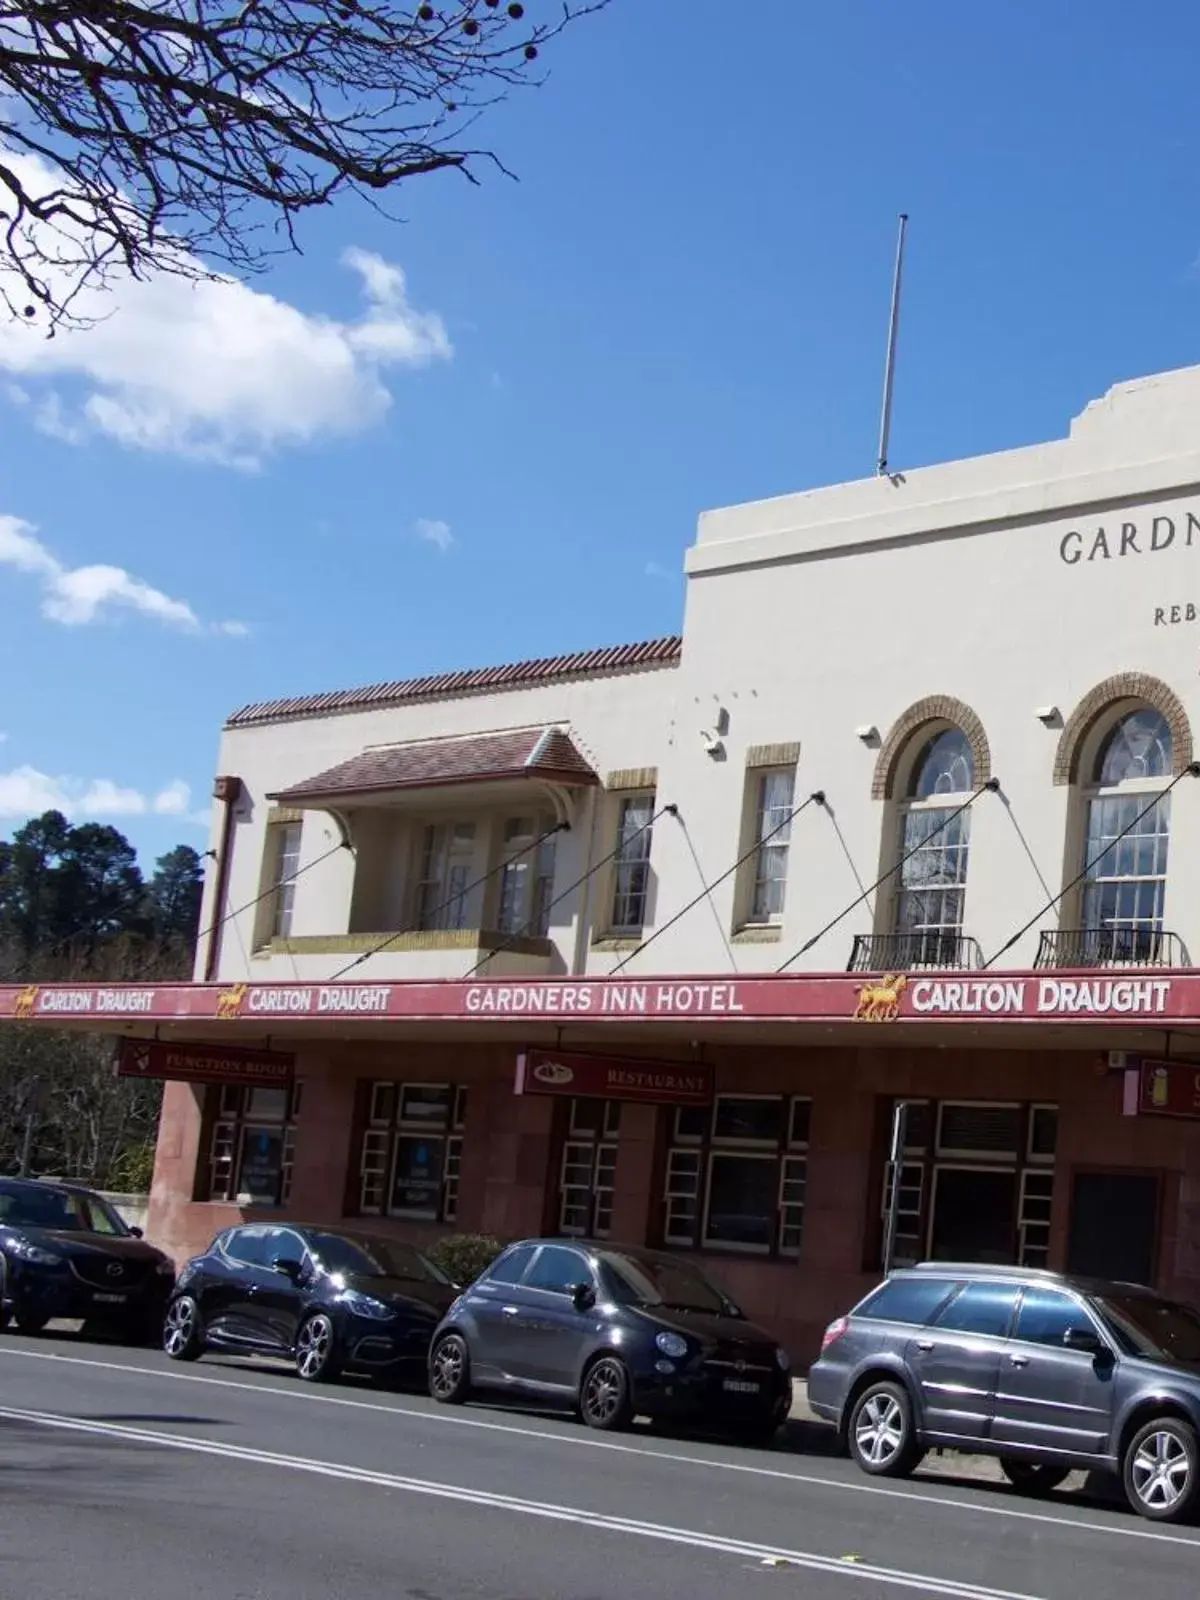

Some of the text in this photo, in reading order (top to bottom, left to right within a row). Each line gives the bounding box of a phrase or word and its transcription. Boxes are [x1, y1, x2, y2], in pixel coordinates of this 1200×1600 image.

[40, 990, 155, 1011] CARLTON DRAUGHT
[248, 988, 391, 1011] CARLTON DRAUGHT
[466, 985, 744, 1011] GARDNERS INN HOTEL
[911, 979, 1171, 1013] CARLTON DRAUGHT
[165, 1053, 241, 1073] FUNCTION
[607, 1067, 705, 1091] RESTAURANT
